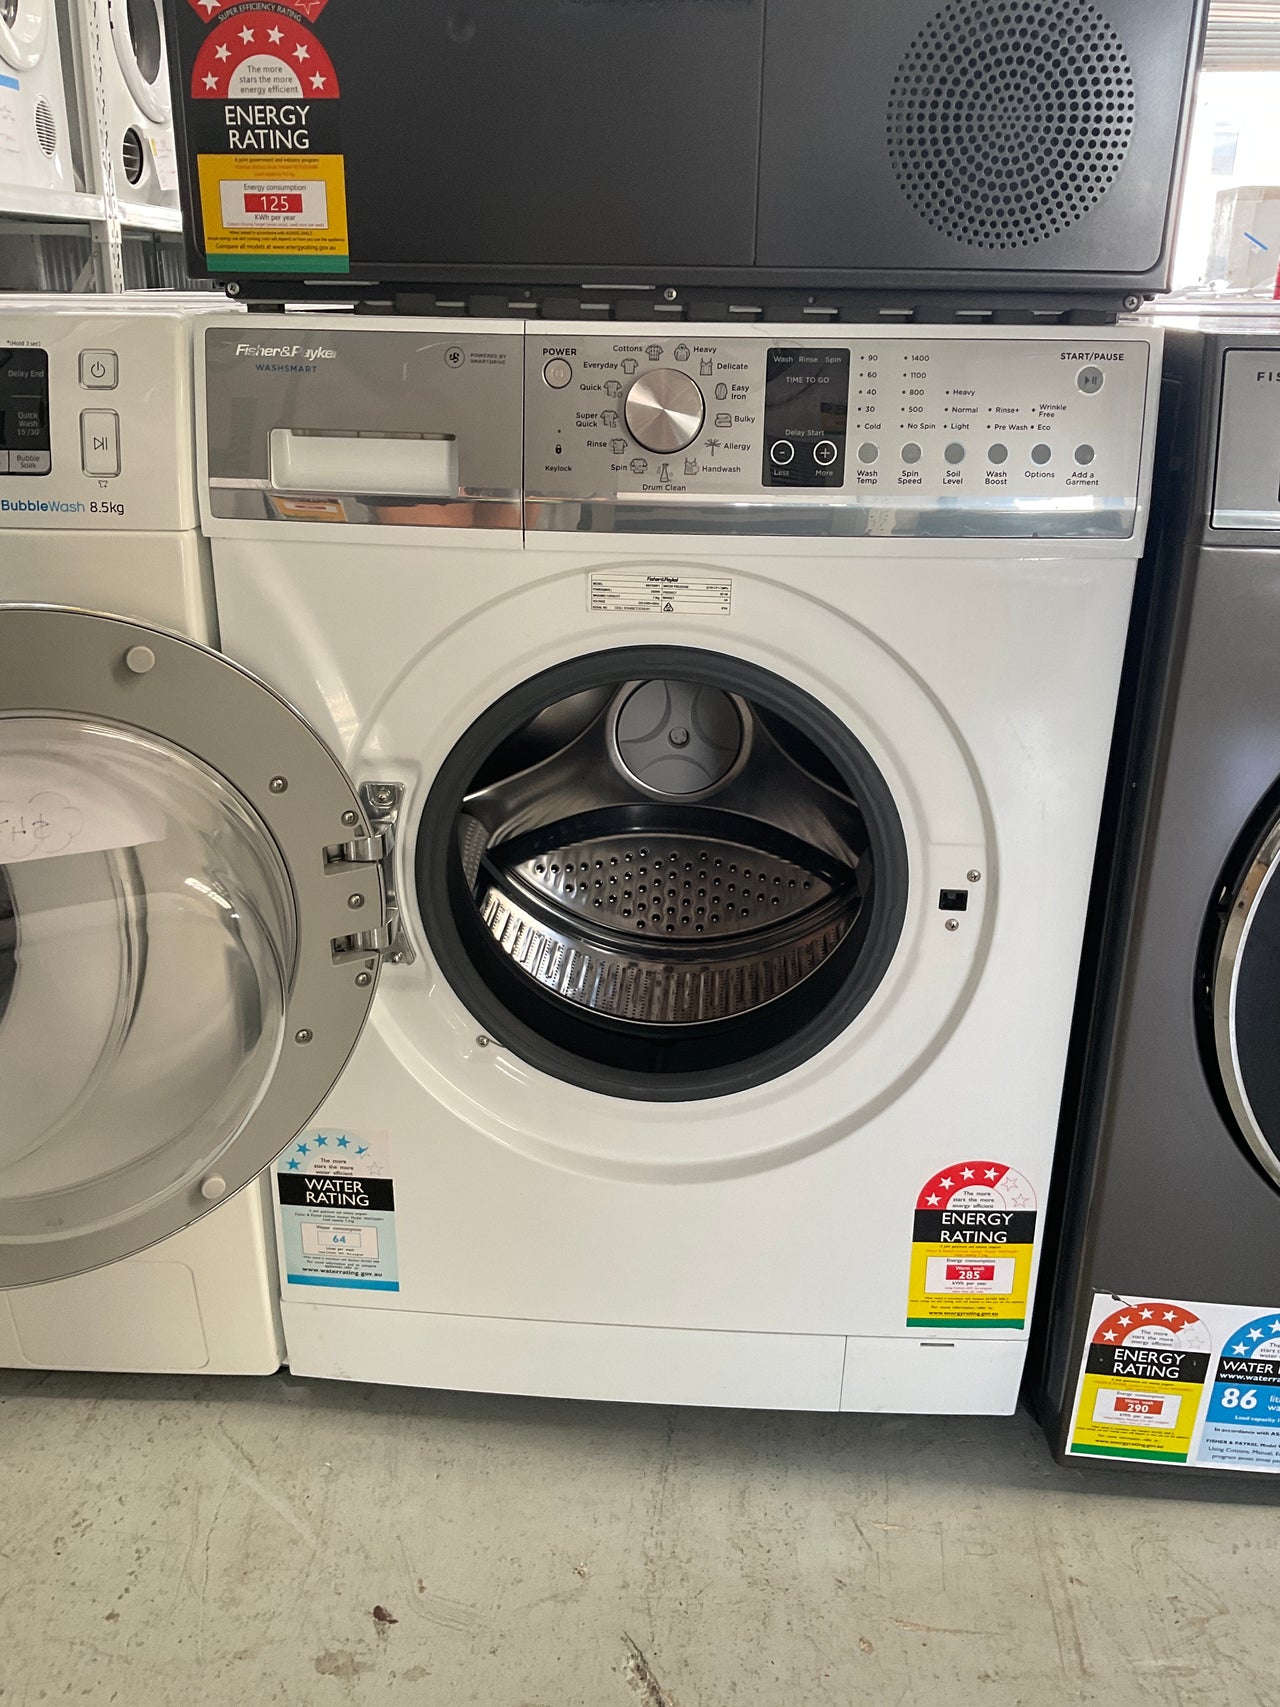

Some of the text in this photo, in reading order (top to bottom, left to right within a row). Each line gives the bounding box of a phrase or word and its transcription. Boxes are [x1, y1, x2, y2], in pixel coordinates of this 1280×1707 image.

[218, 3, 302, 21] SUPER EFFICIENCY RATING
[240, 85, 298, 95] energy efficient
[224, 105, 310, 126] ENERGY
[228, 129, 310, 150] RATING
[244, 184, 265, 192] Energy
[260, 196, 289, 211] 125
[542, 348, 577, 356] POWER
[693, 346, 717, 354] Heavy
[825, 356, 842, 364] Spin
[1060, 352, 1124, 361] START/PAUSE
[256, 364, 316, 372] WASHSMART
[583, 362, 618, 370] Everyday
[717, 362, 748, 370] Delicate
[8, 370, 29, 378] Delay
[731, 385, 750, 393] Easy
[953, 389, 975, 397] Heavy
[611, 391, 622, 399] 30
[576, 412, 598, 420] Super
[576, 420, 597, 428] Quick
[785, 429, 806, 437] Delay
[724, 442, 751, 451] Allergy
[902, 470, 919, 478] Spin
[1024, 471, 1055, 479] Options
[857, 477, 877, 485] Temp
[1, 500, 125, 515] BubbleWash 8.5kg
[305, 1178, 364, 1193] WATER
[306, 1191, 369, 1206] RATING
[941, 1212, 1013, 1225] ENERGY
[333, 1235, 346, 1243] 64
[940, 1231, 1007, 1243] RATING
[959, 1271, 980, 1279] 285
[1114, 1348, 1185, 1365] ENERGY
[1113, 1362, 1180, 1379] RATING
[1223, 1361, 1273, 1374] WATER
[1221, 1388, 1257, 1409] 86
[1127, 1403, 1149, 1412] 290
